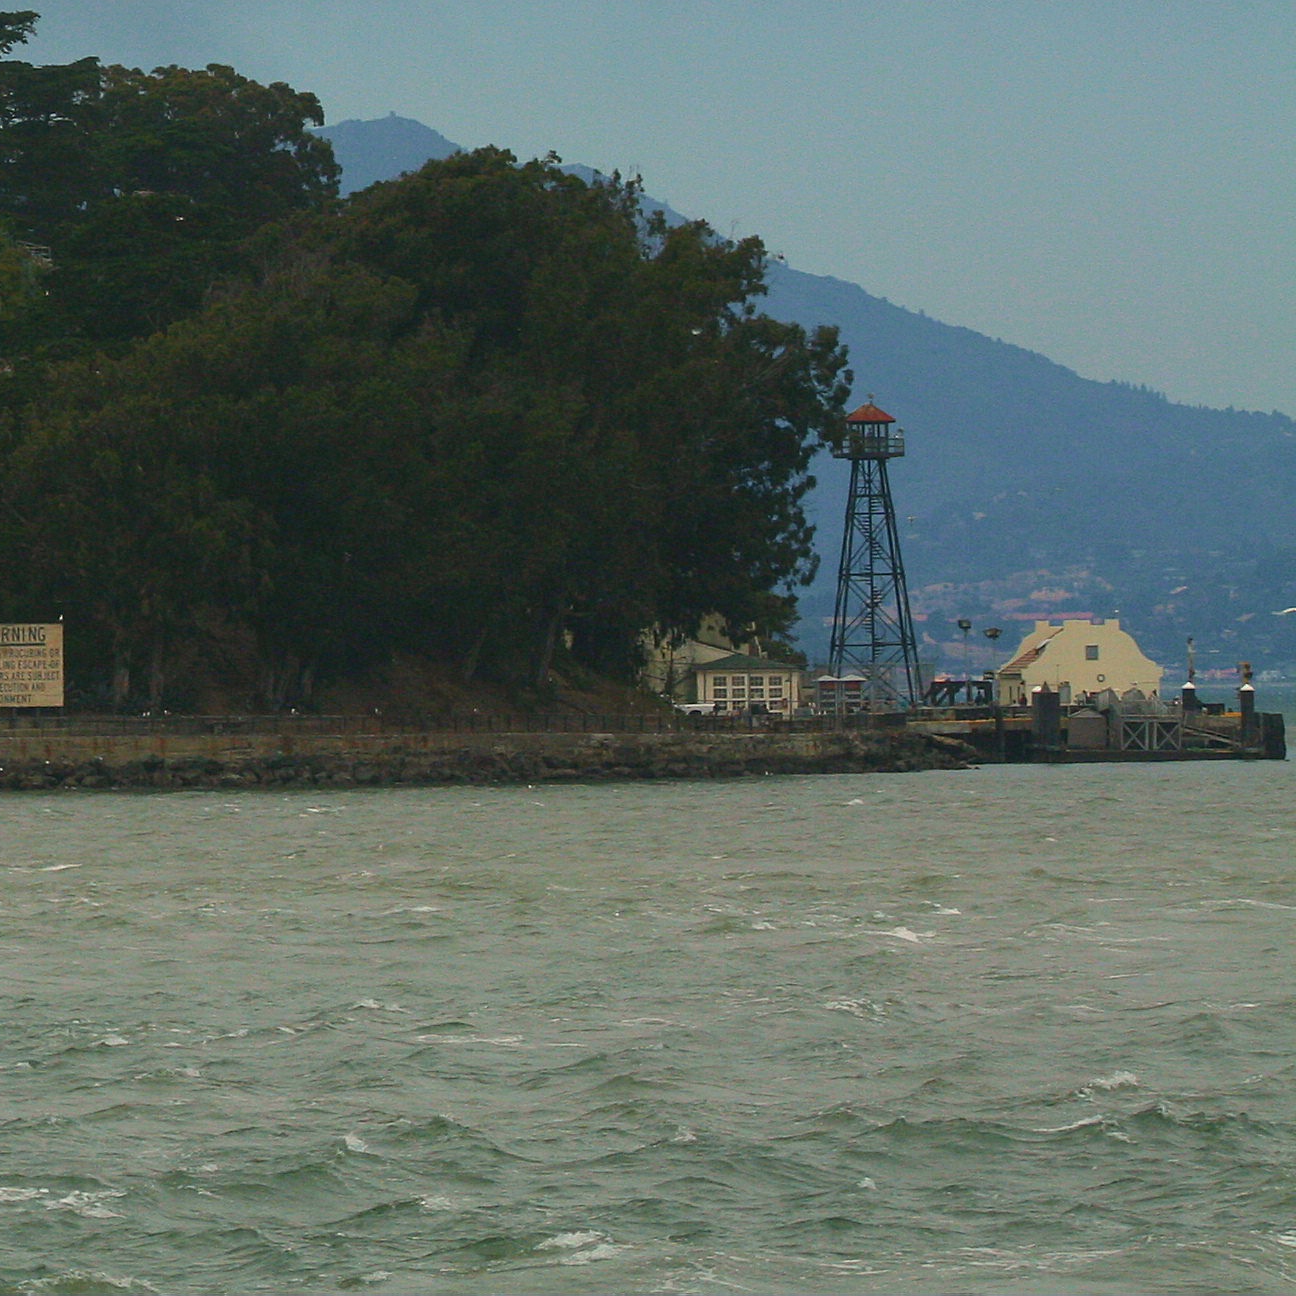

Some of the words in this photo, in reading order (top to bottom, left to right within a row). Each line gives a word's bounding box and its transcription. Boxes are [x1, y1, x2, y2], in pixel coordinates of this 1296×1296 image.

[49, 648, 60, 658] OR
[18, 660, 47, 669] ESCAPE
[11, 671, 25, 680] ARE
[27, 671, 60, 680] SUBJECT
[31, 682, 46, 692] AND
